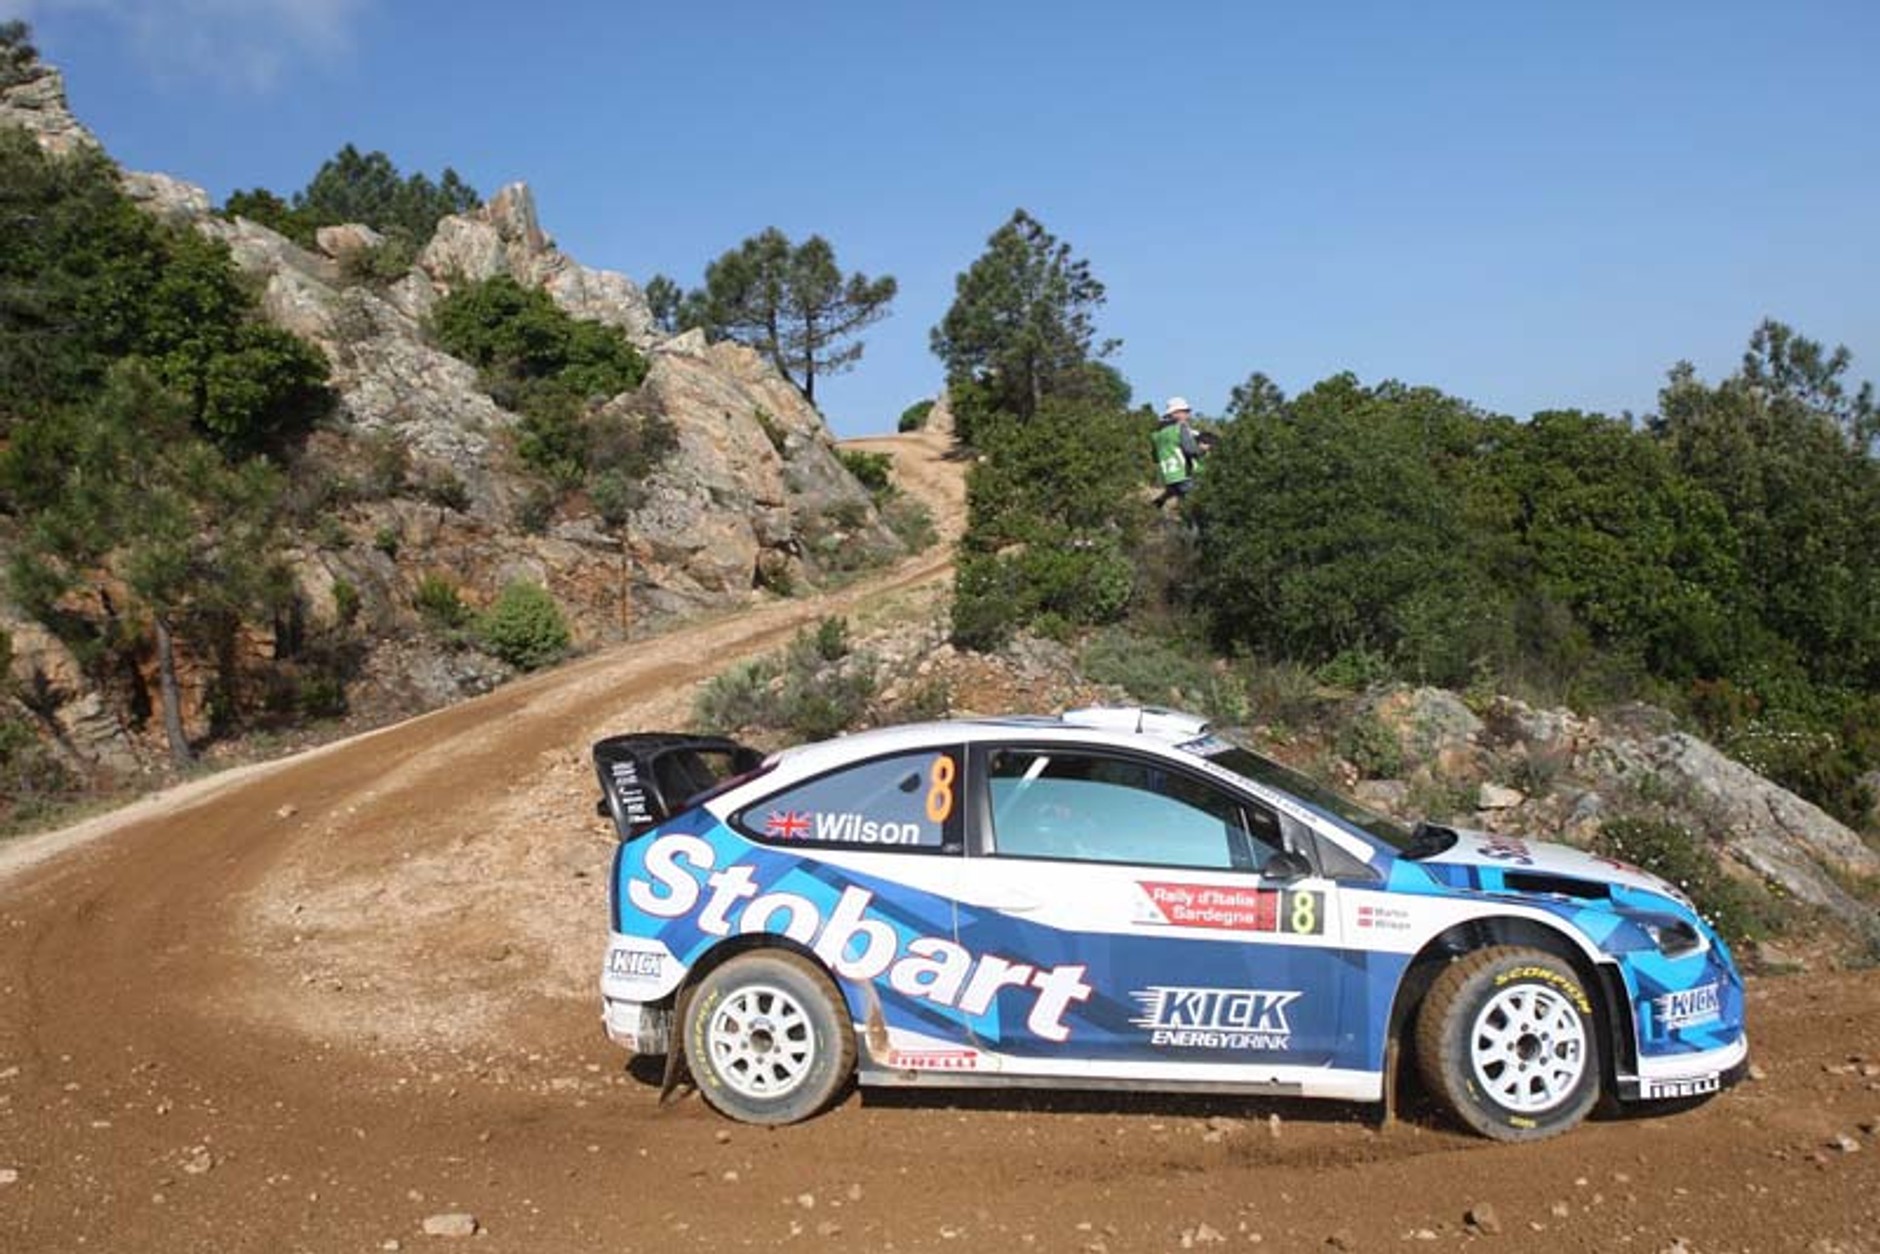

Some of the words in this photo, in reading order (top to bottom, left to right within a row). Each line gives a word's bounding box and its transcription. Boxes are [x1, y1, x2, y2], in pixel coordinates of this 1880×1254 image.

[926, 755, 955, 823] 8
[816, 813, 920, 844] Wilson
[1153, 887, 1194, 907] Rally
[1292, 891, 1315, 934] 8
[1173, 904, 1256, 926] Sardegna
[628, 833, 1092, 1042] Stobart
[611, 949, 667, 978] KICK
[1142, 986, 1303, 1034] KICK
[1662, 983, 1720, 1019] KICK
[1640, 1071, 1721, 1099] PIRELLI
